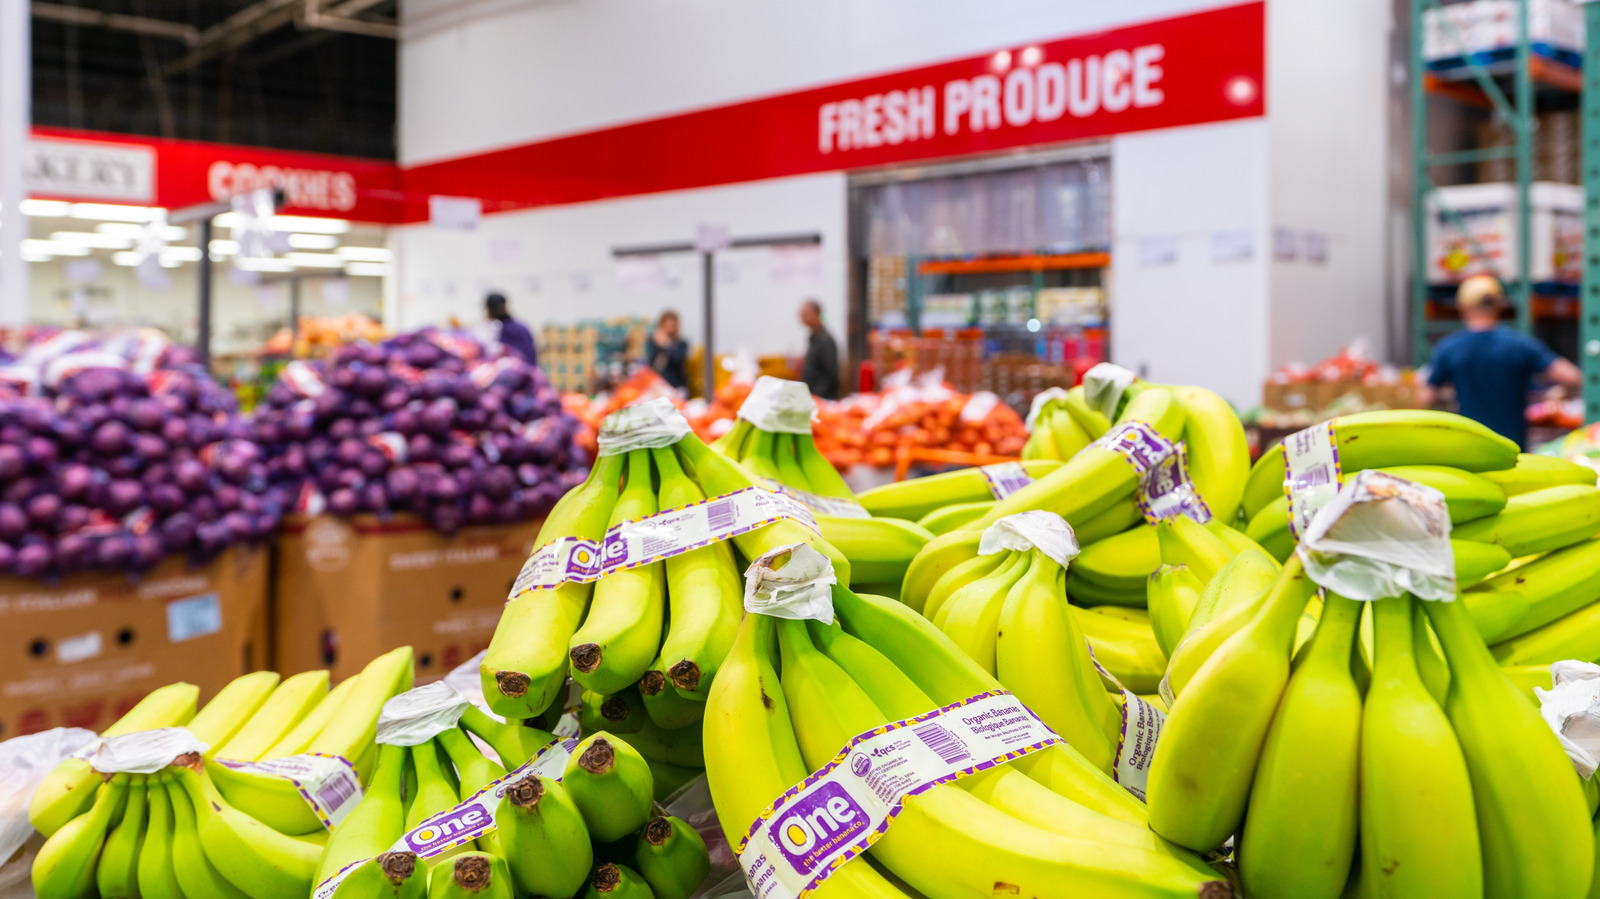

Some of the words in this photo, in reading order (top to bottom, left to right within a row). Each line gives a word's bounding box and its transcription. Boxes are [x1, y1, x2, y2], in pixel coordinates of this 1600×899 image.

[819, 84, 936, 154] FRESH
[944, 43, 1166, 134] PRODUCE
[571, 540, 625, 569] One
[962, 711, 994, 726] Organic
[971, 721, 1006, 735] Biologique
[880, 744, 896, 756] qcs
[1129, 729, 1145, 766] Organic
[1136, 728, 1154, 770] Biologique
[411, 810, 484, 846] One
[432, 835, 453, 846] better
[453, 825, 477, 836] banana
[779, 796, 856, 856] One
[803, 855, 815, 867] the
[812, 841, 833, 857] better
[831, 826, 855, 844] banana
